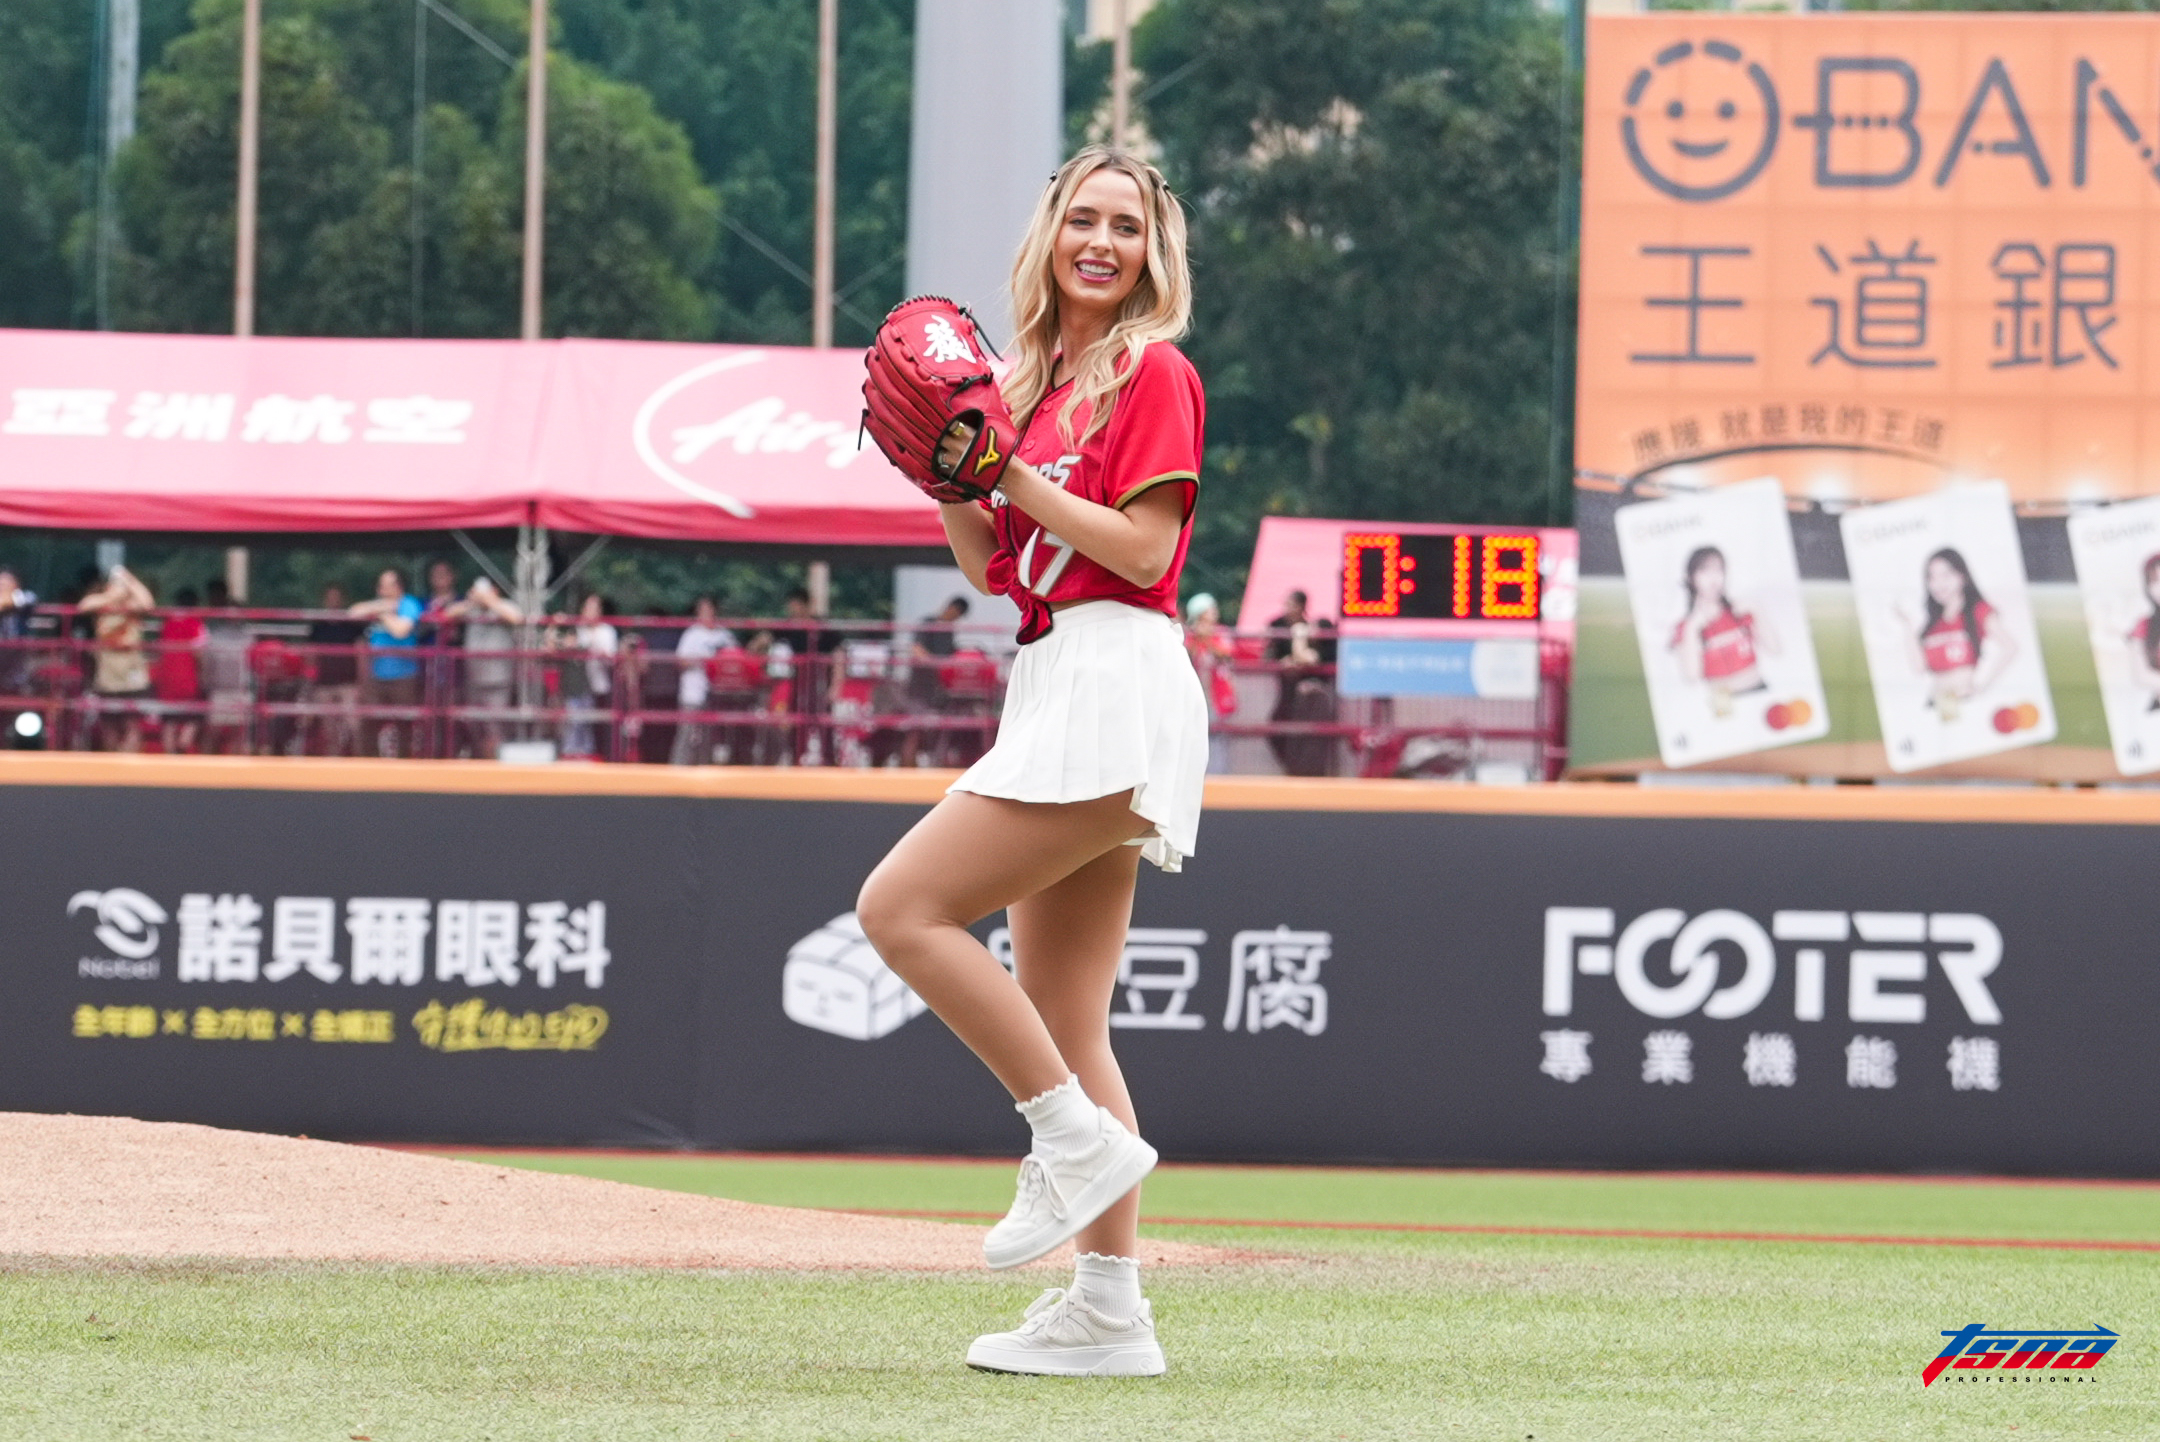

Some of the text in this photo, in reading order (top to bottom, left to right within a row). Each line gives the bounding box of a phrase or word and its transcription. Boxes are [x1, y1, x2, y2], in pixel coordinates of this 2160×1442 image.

[1629, 238, 2120, 370] 王道銀
[3, 388, 473, 444] 亞洲航空
[1343, 532, 1541, 620] 0:18
[177, 892, 611, 988] 諾貝爾眼科
[987, 925, 1332, 1036] 豆腐
[1542, 906, 2004, 1025] FOOTER
[1540, 1029, 2001, 1091] 專業機能襪
